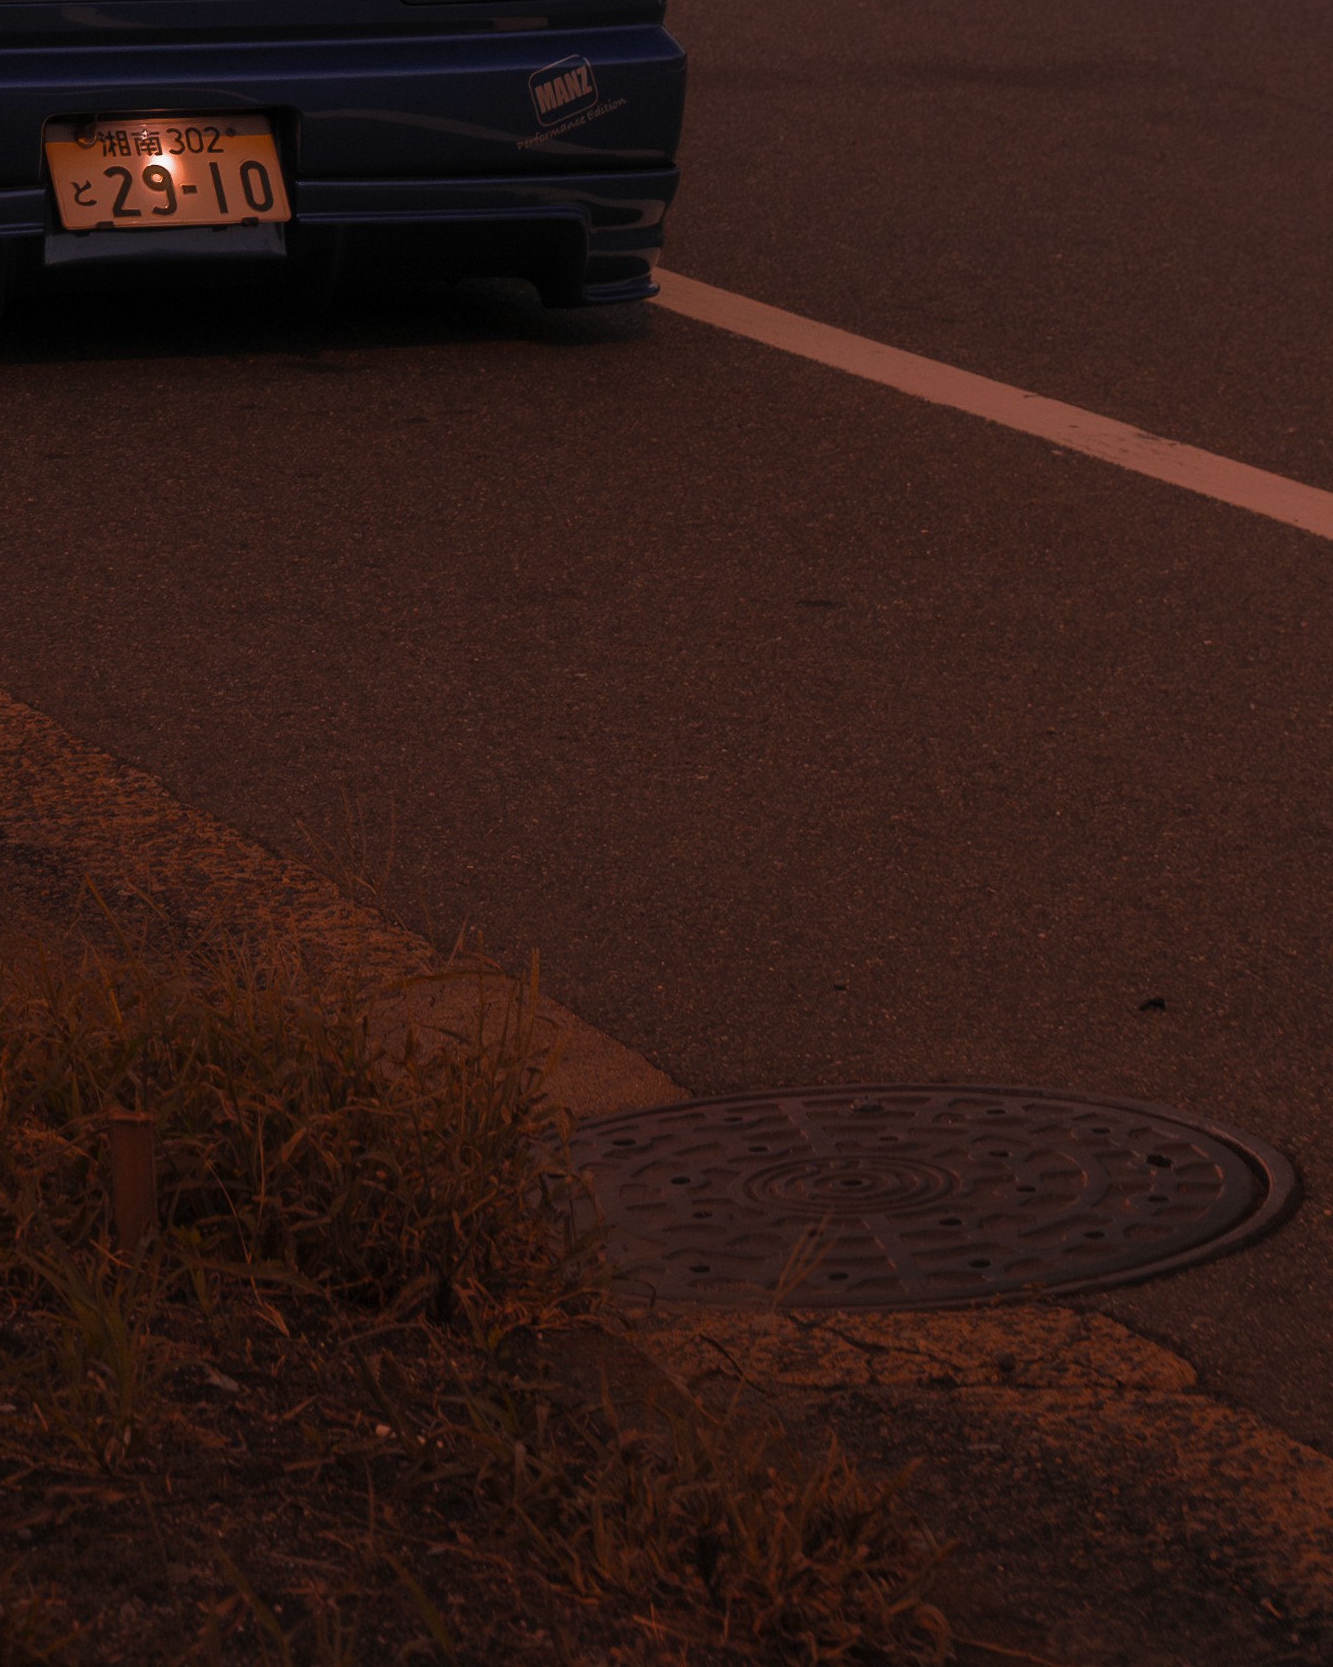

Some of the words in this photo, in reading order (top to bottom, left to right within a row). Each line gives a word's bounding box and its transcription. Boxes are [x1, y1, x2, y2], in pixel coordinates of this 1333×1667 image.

[534, 65, 593, 114] MANZ
[71, 179, 97, 207] と
[103, 160, 274, 218] 29-10
